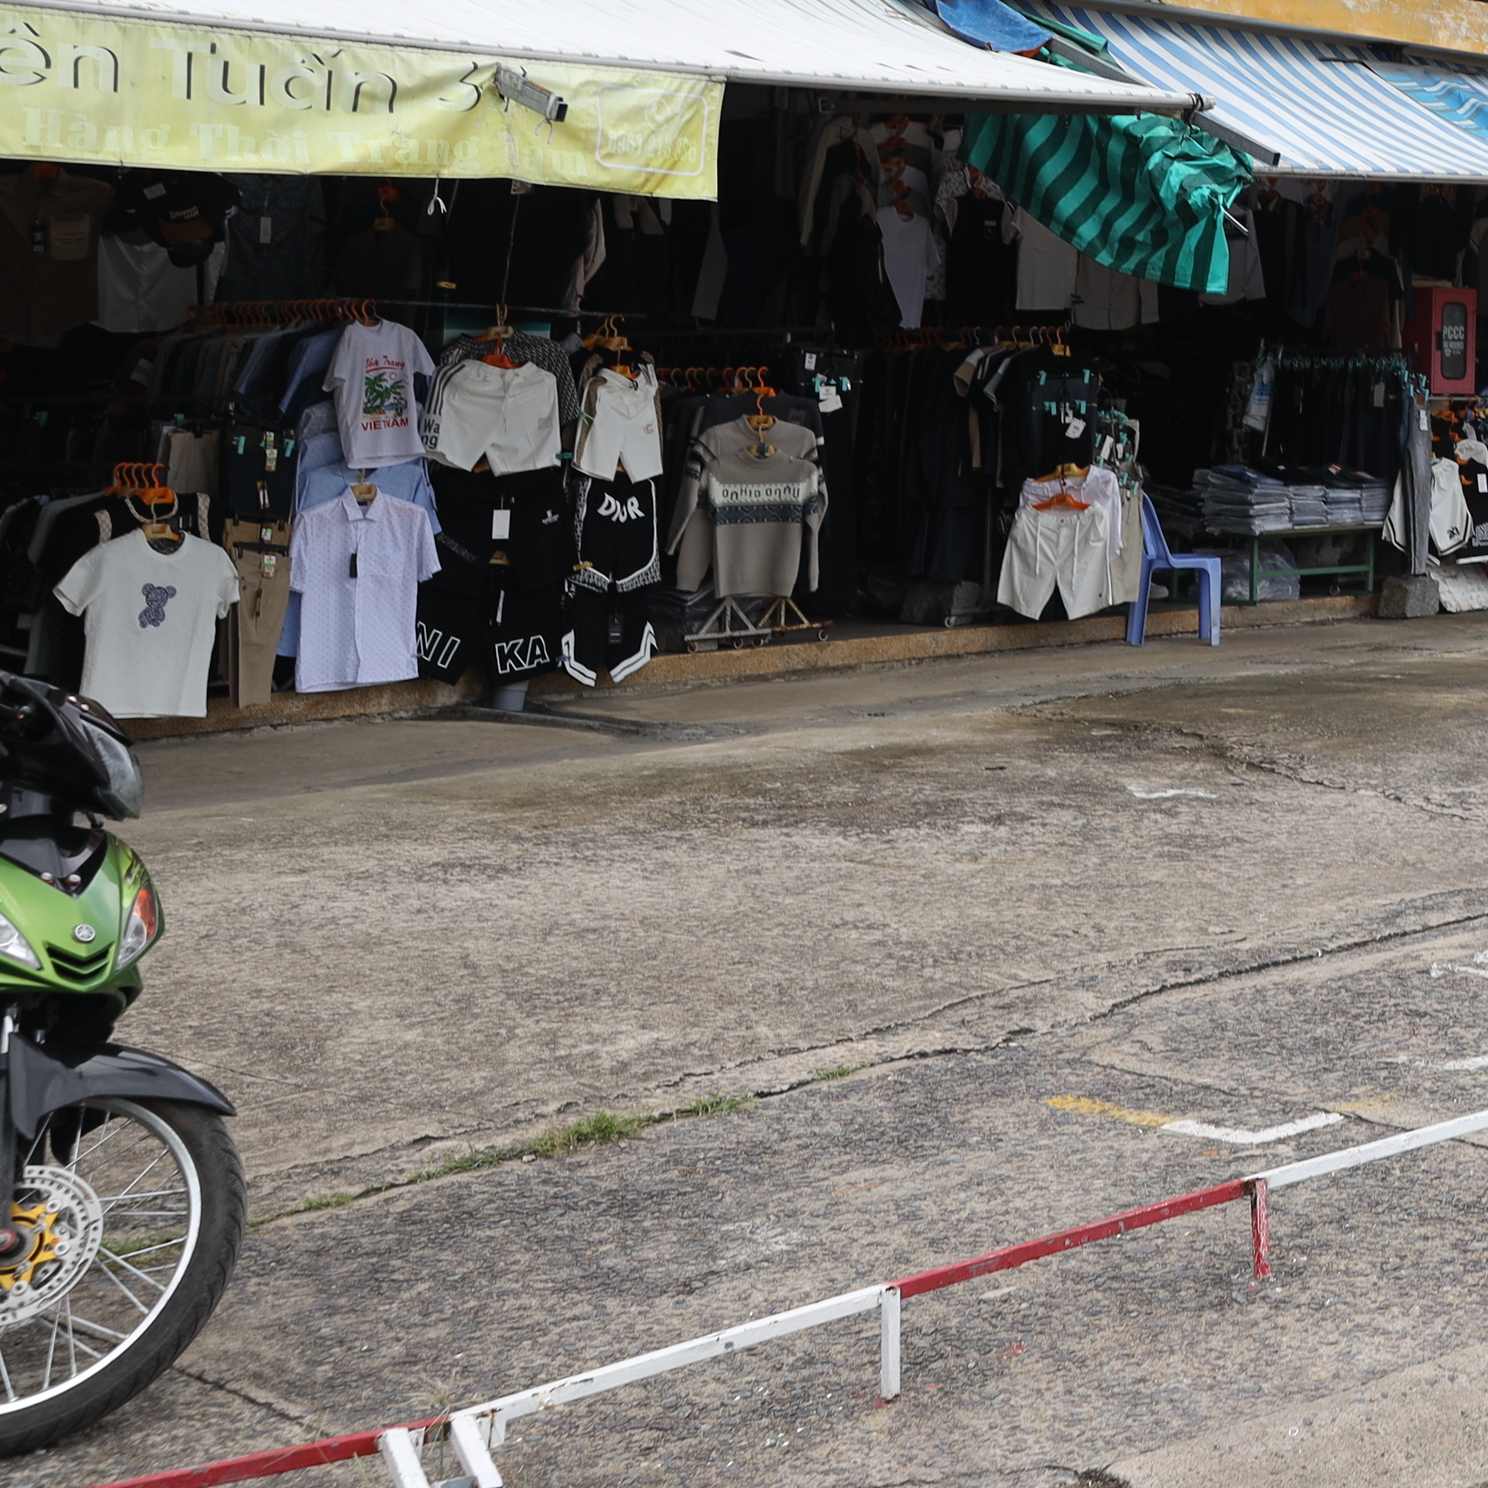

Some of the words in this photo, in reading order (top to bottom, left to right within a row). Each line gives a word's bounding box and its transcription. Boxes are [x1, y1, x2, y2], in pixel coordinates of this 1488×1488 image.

[151, 37, 398, 113] Tuấn
[22, 107, 171, 161] Hàng
[189, 122, 311, 164] Thời
[327, 132, 481, 175] Trang
[1443, 325, 1465, 340] PCCC
[360, 417, 409, 432] VIETNAM
[495, 635, 550, 674] KA
